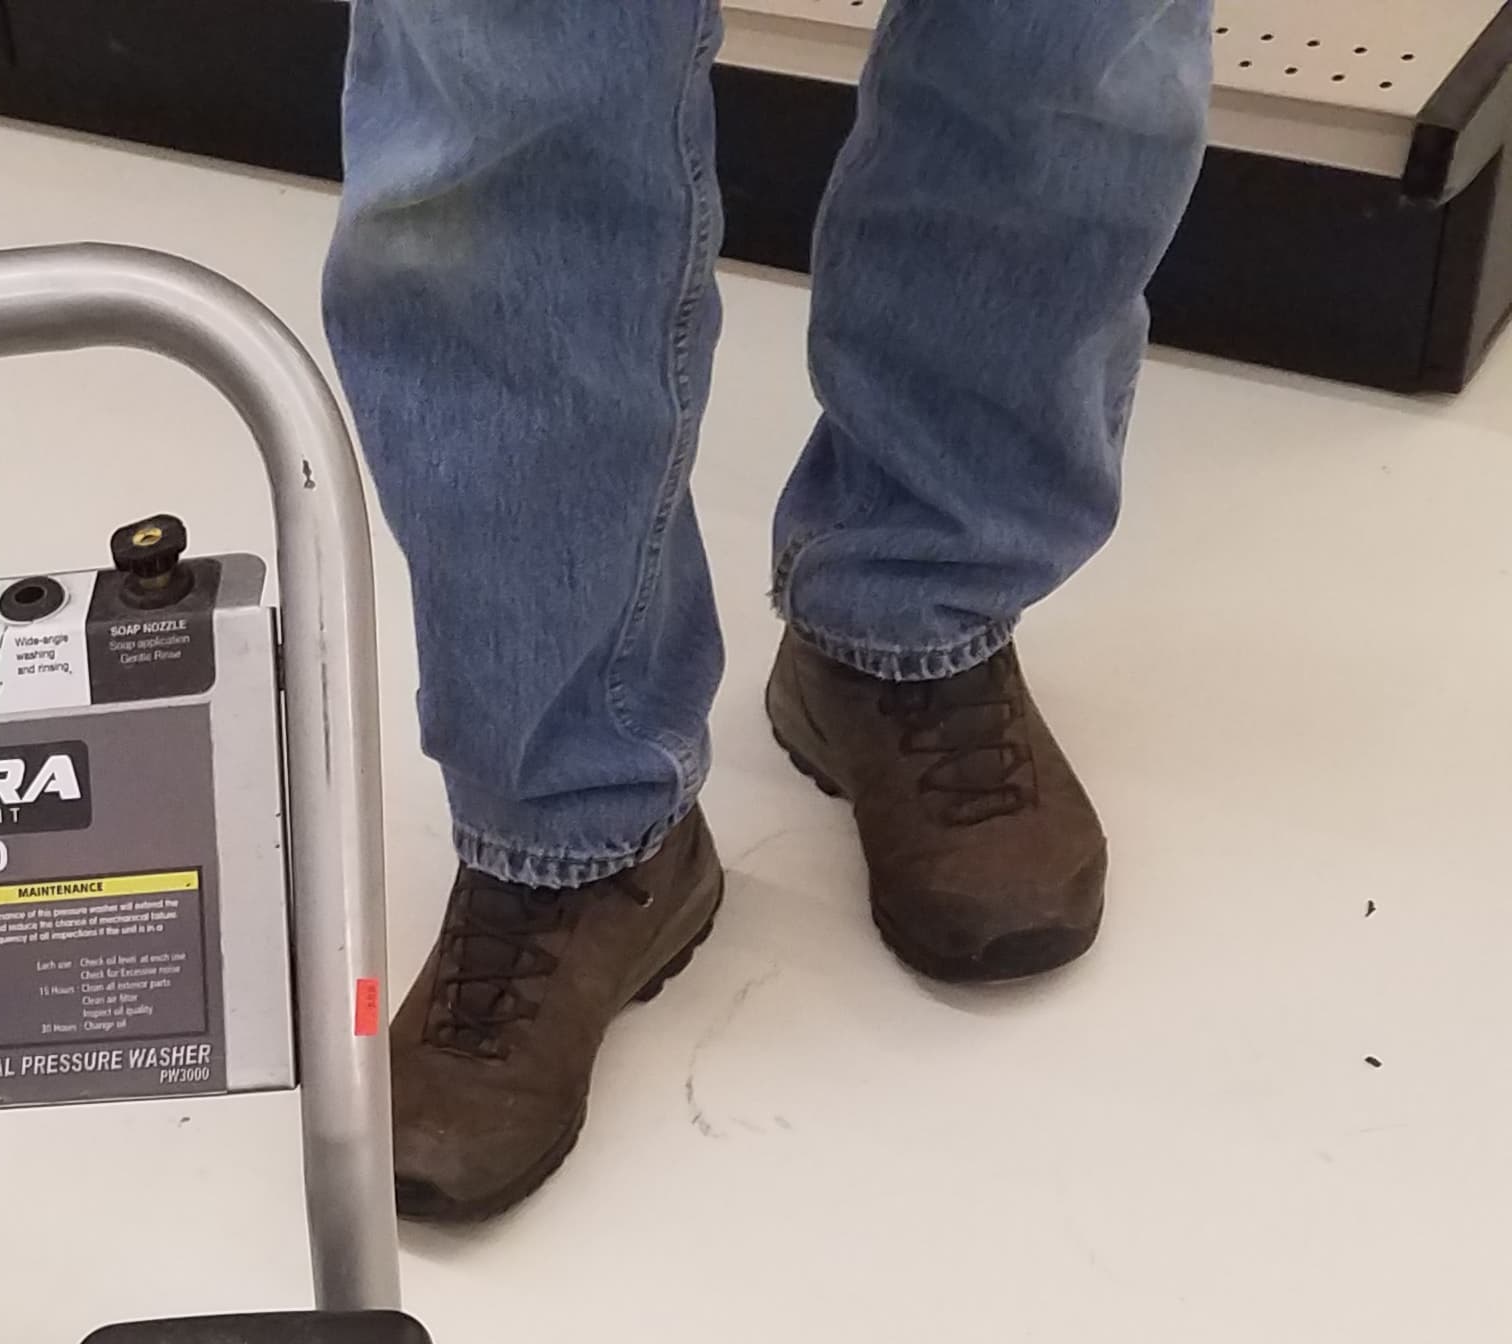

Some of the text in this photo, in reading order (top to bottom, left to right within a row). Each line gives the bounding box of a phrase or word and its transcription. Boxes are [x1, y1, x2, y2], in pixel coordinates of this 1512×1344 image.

[110, 619, 187, 637] SOAP NOZZLE
[14, 634, 69, 647] Wide-angle
[109, 634, 190, 651] Soap application
[16, 650, 55, 661] washing
[120, 650, 182, 664] Gentle Rinse
[18, 664, 35, 675] and
[18, 882, 104, 898] MAINTENANCE
[21, 1050, 123, 1076] PRESSURE
[128, 1044, 212, 1069] WASHER
[159, 1066, 210, 1084] PW3000
